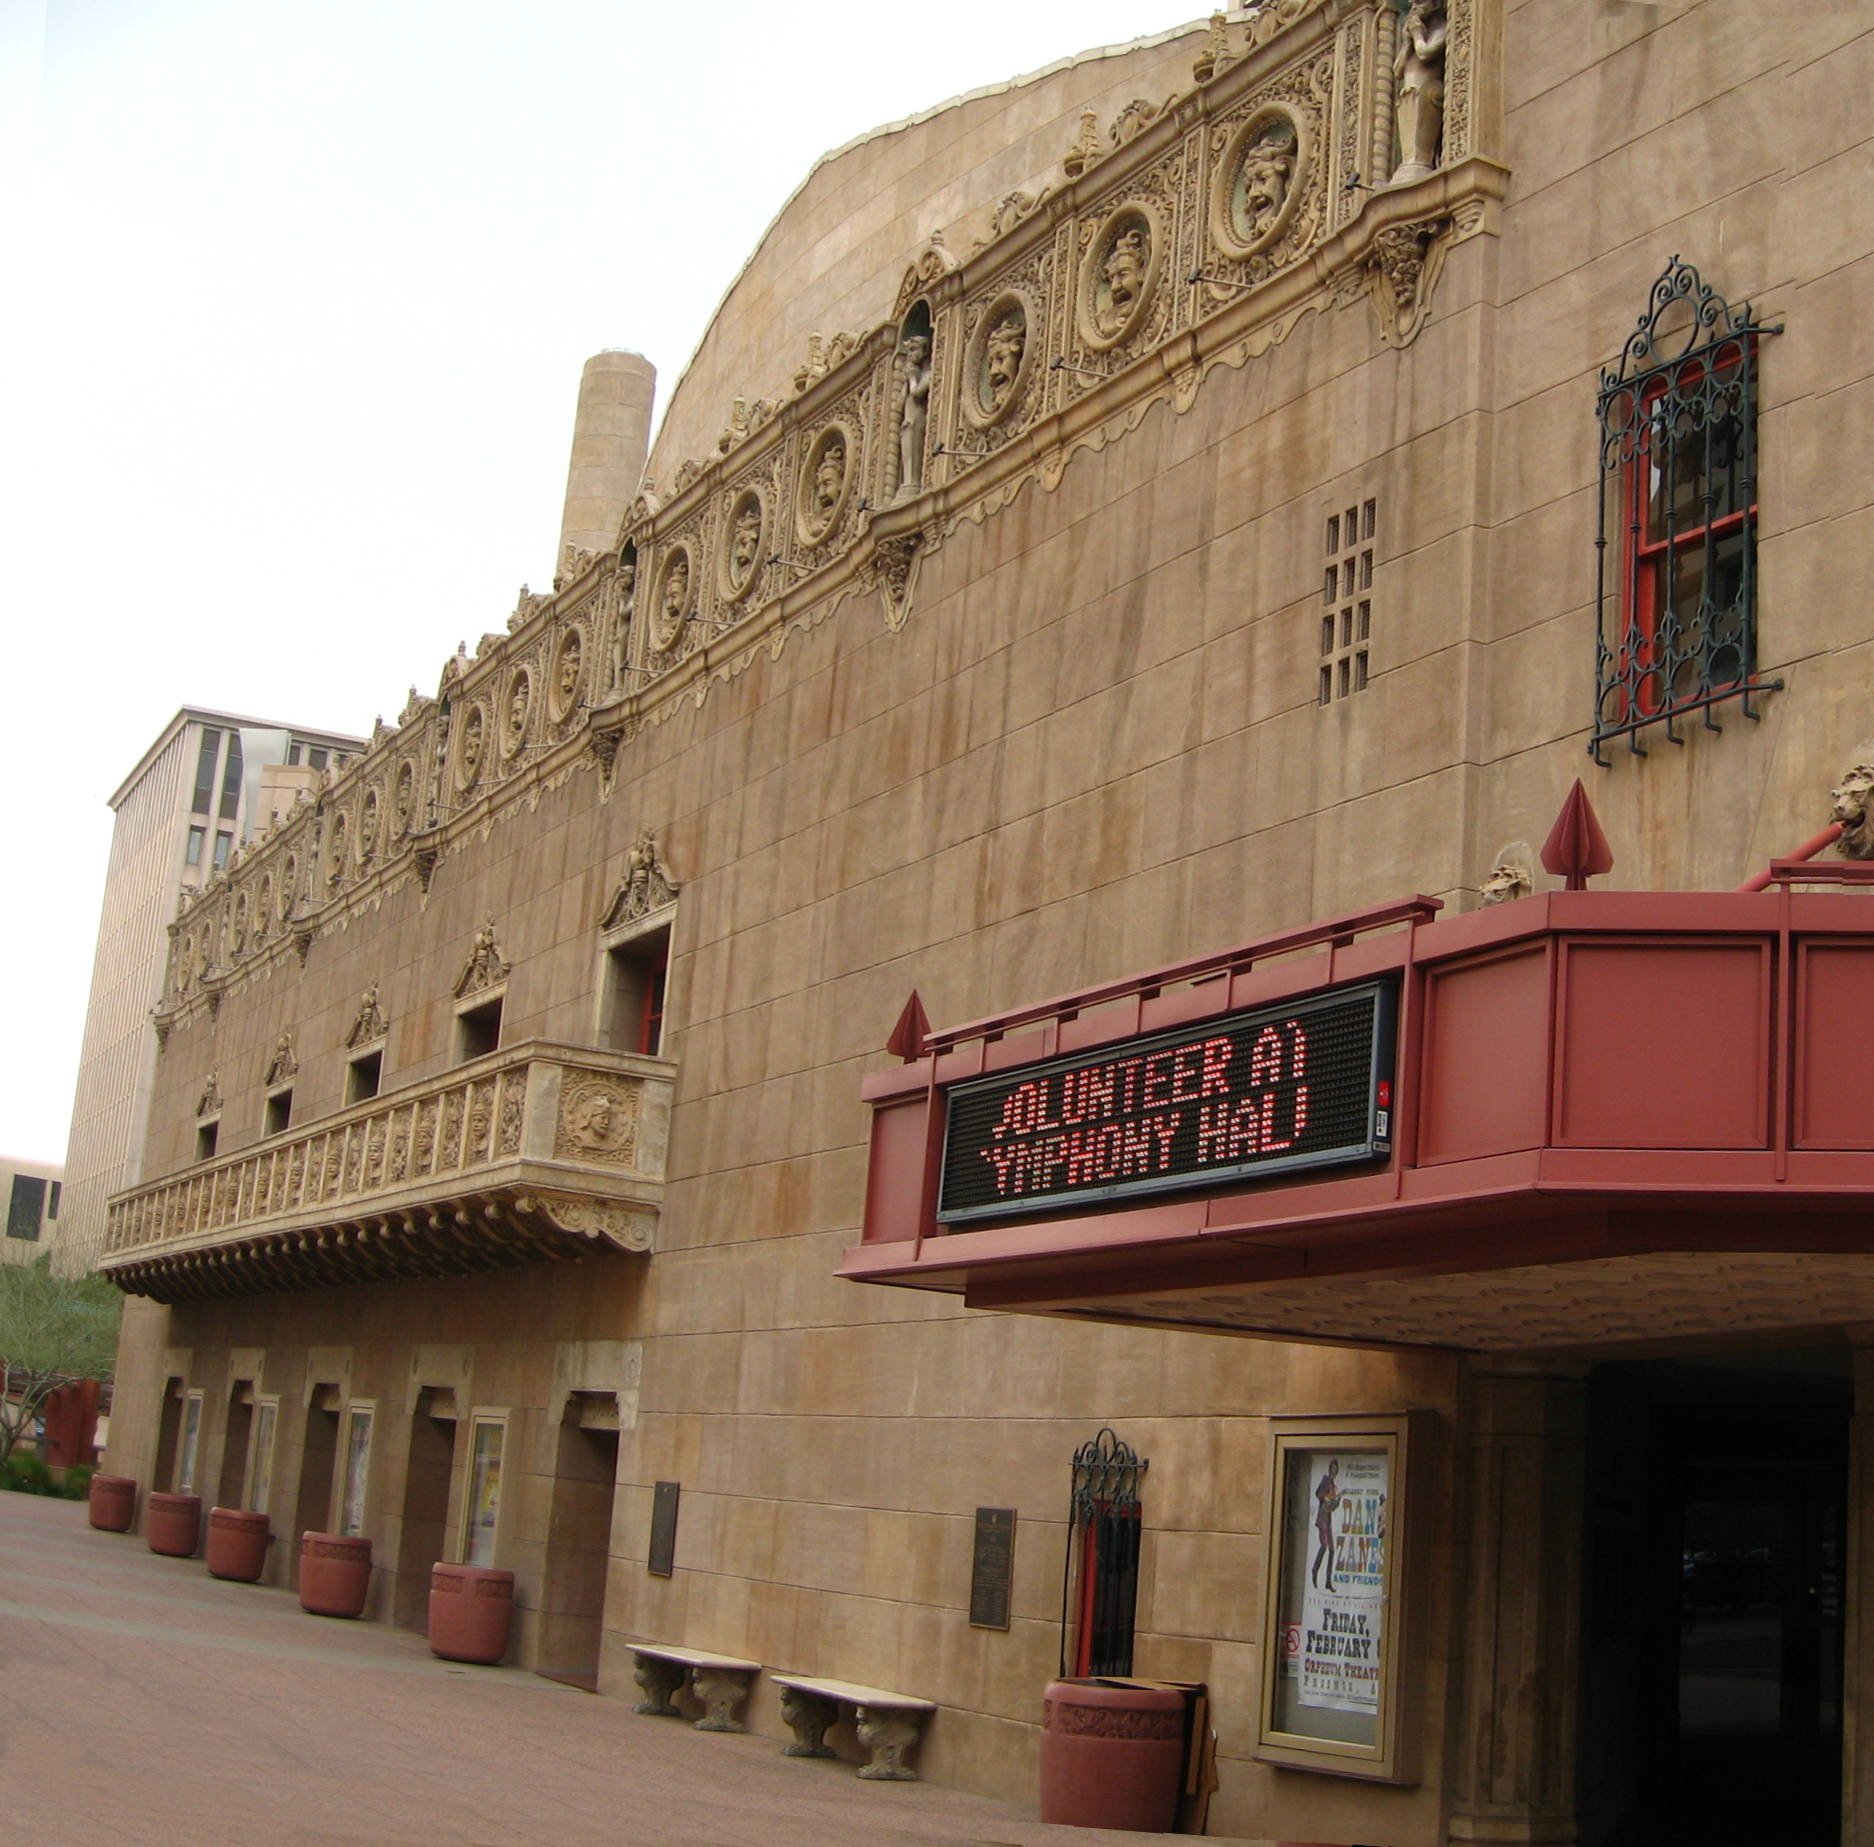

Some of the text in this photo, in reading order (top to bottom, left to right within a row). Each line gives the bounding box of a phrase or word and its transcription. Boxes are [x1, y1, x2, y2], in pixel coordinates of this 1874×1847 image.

[980, 1110, 1184, 1196] YMPHONY
[1341, 1498, 1378, 1535] DAN
[1333, 1573, 1351, 1584] AND
[1322, 1608, 1370, 1638] FRIDAY,
[1305, 1630, 1371, 1659] FEBRUARY
